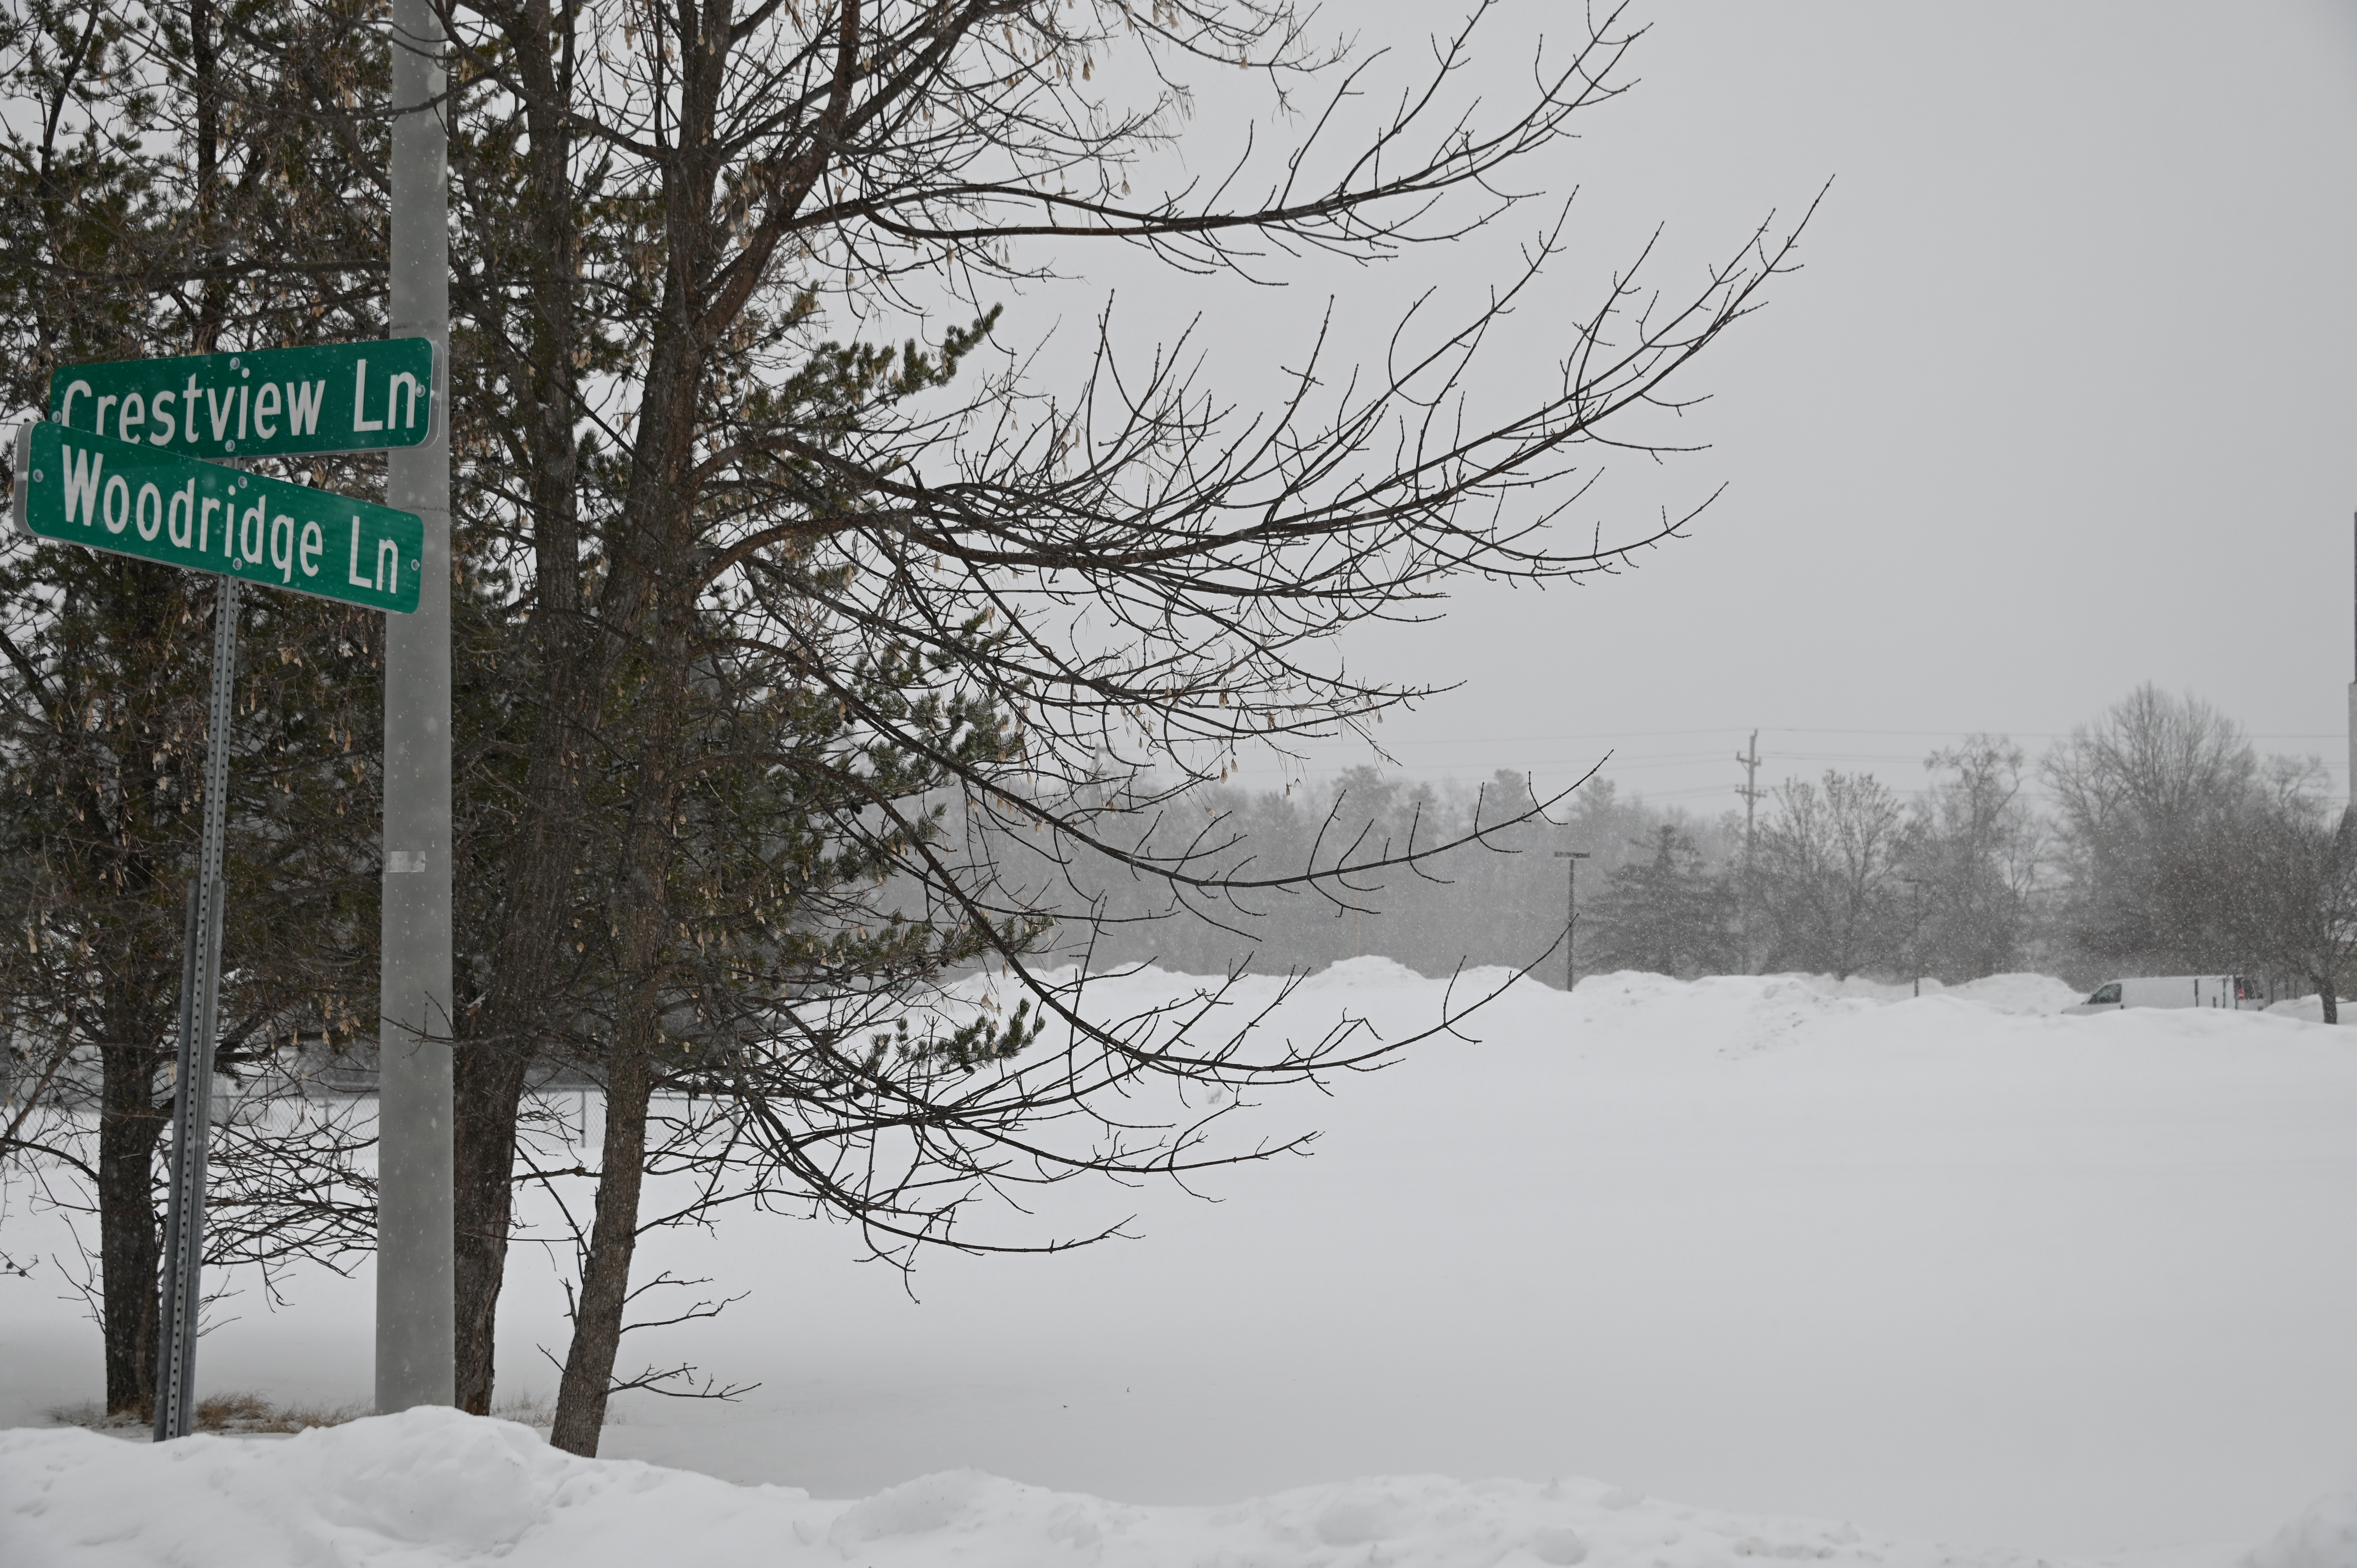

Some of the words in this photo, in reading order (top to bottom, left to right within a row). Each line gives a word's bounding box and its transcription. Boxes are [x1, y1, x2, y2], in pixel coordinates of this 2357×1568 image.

[62, 367, 326, 446] Crestview
[353, 359, 416, 432] Ln
[62, 444, 323, 584] Woodridge
[349, 515, 399, 594] Ln
